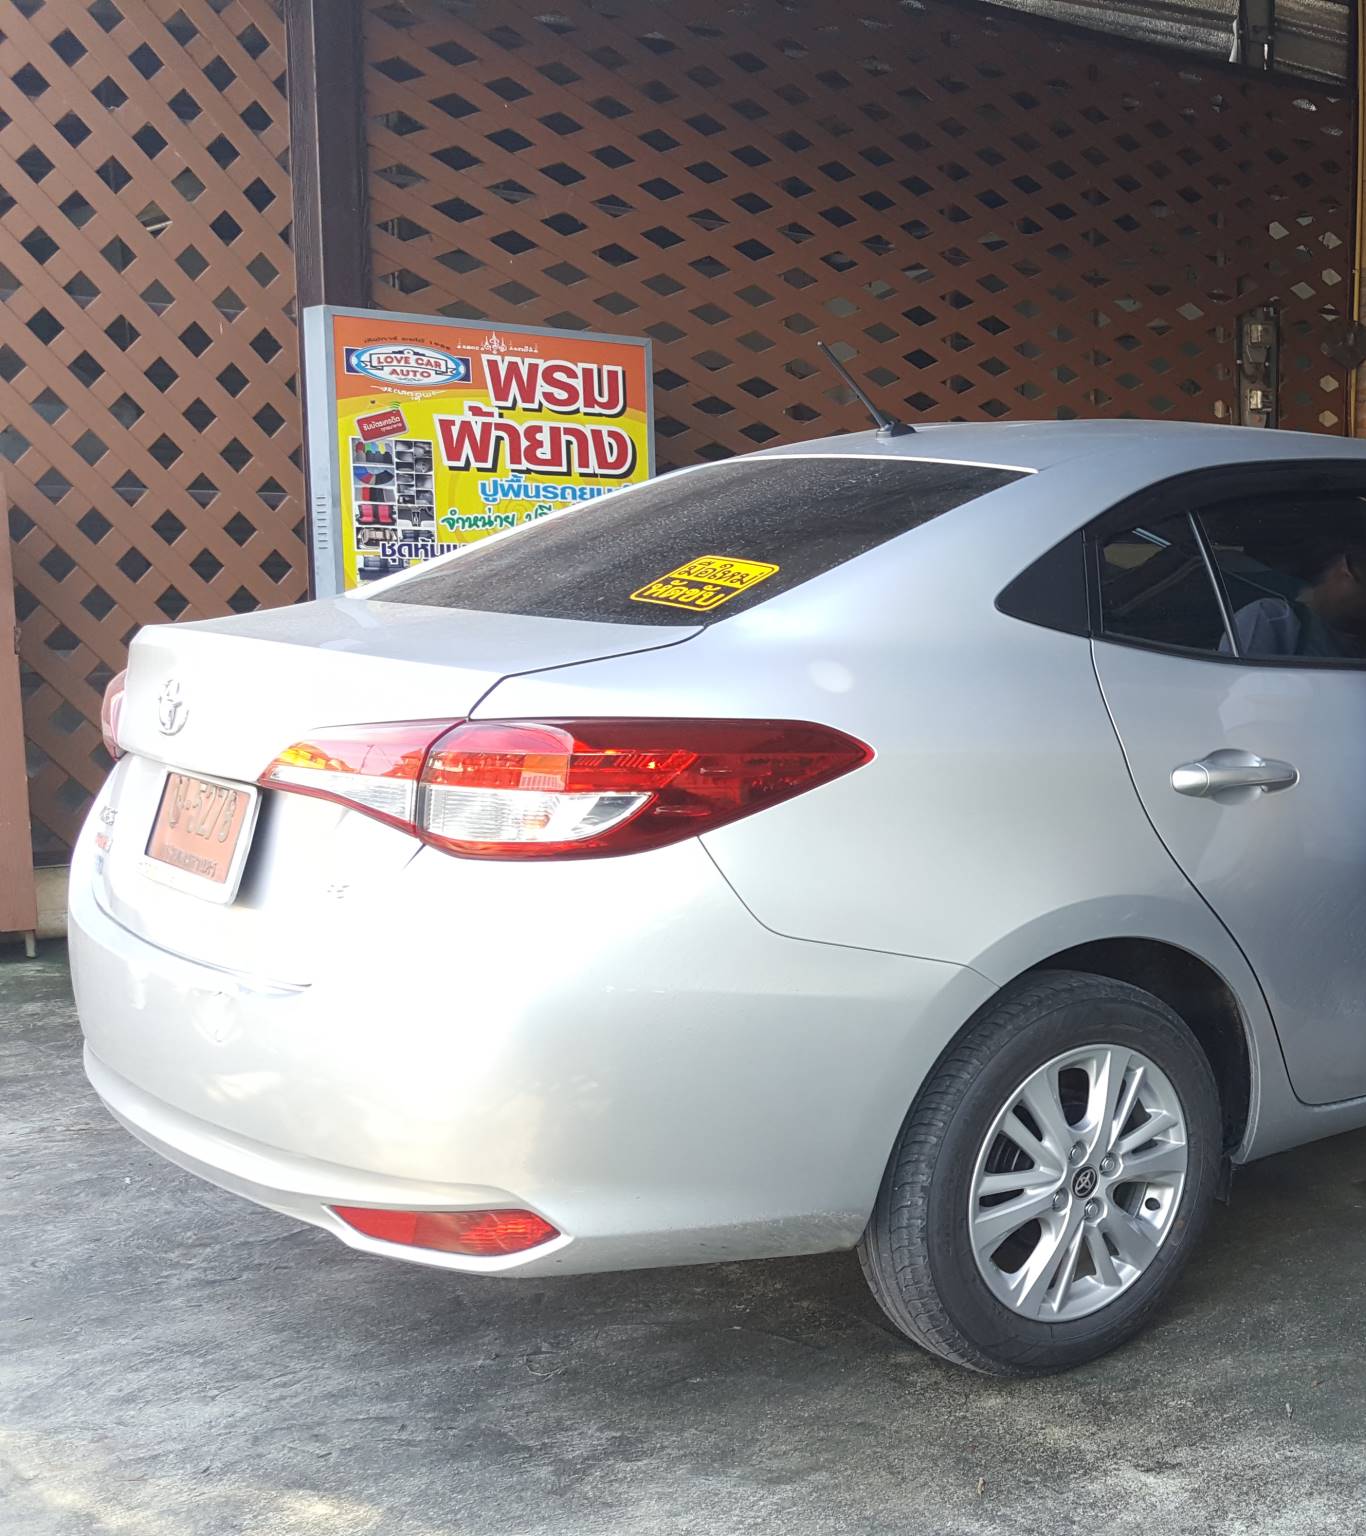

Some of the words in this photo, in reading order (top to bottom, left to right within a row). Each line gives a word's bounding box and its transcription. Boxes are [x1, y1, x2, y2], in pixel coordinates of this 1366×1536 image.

[375, 355, 413, 366] LOVE
[414, 357, 443, 370] CAR
[388, 367, 433, 379] AUTO
[484, 356, 624, 413] พรม
[436, 403, 632, 472] ผ้ายาง
[440, 508, 516, 531] จำหน่าย
[678, 560, 765, 586] มือใหม่
[643, 579, 726, 606] หัดขับ
